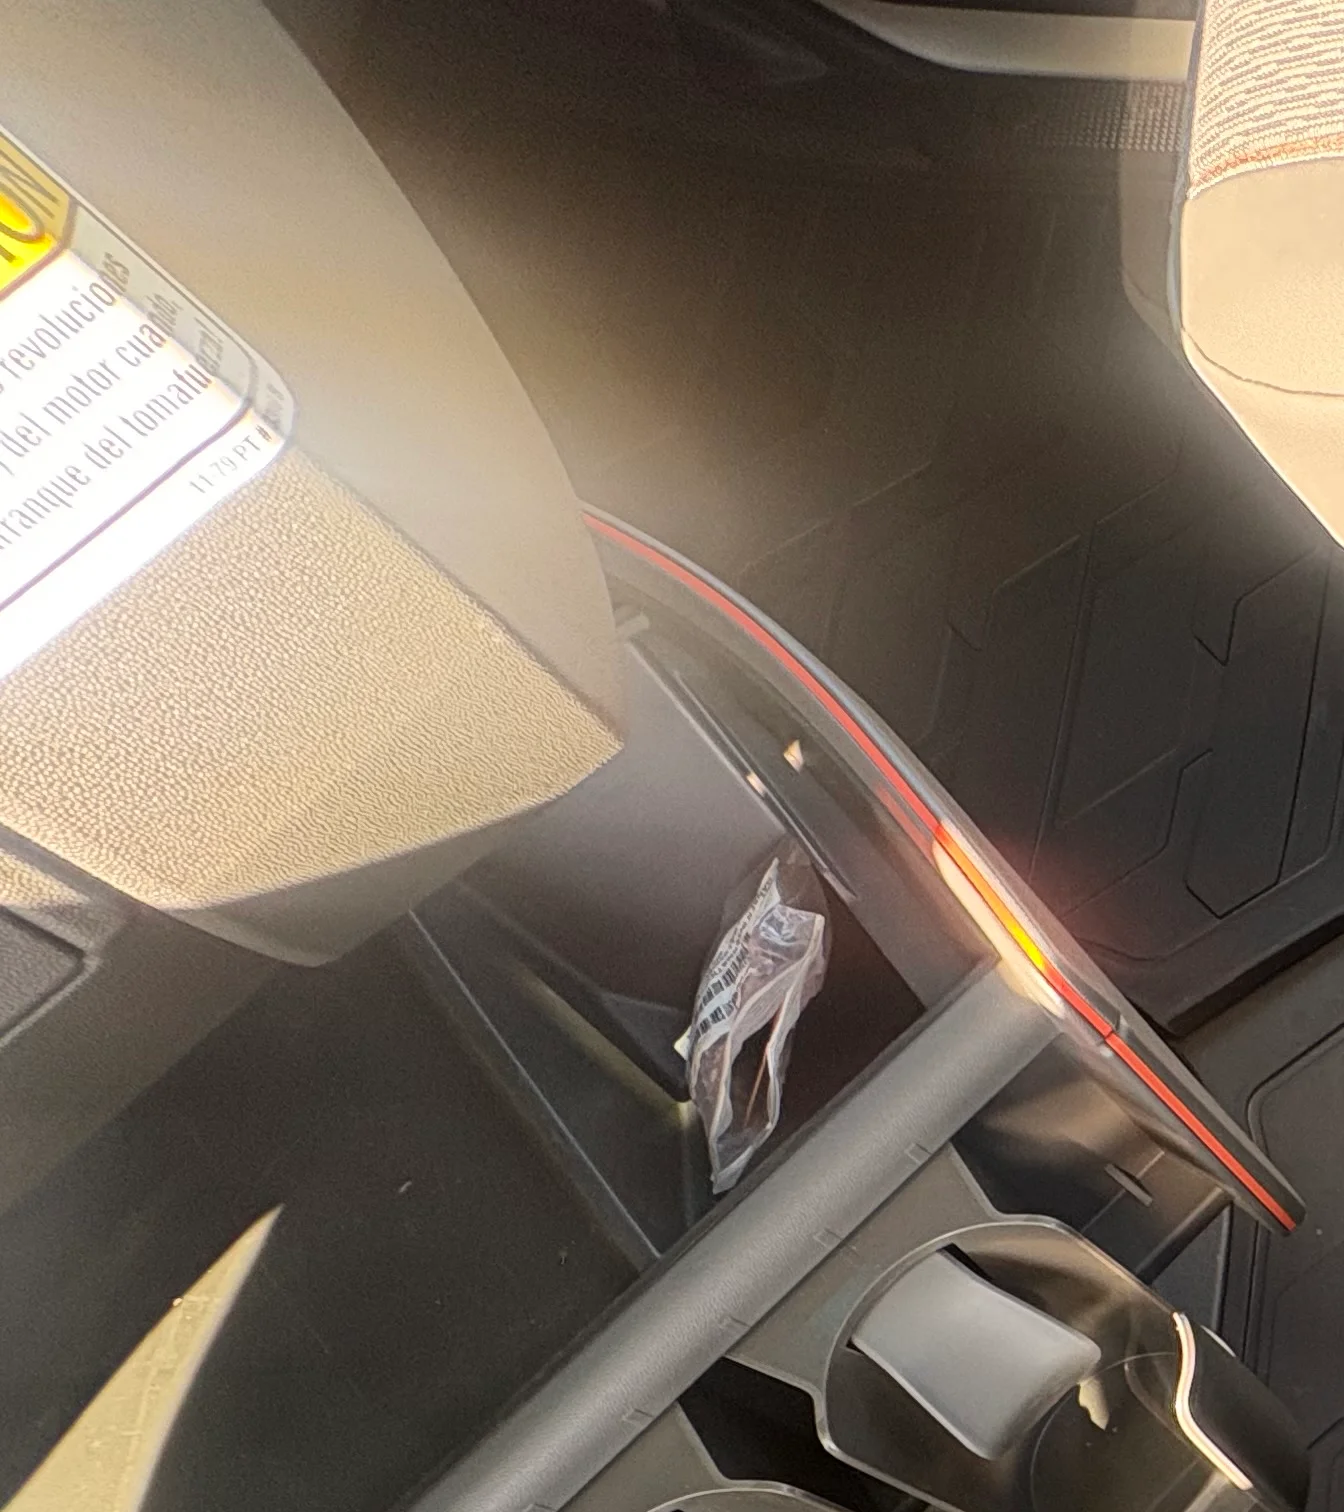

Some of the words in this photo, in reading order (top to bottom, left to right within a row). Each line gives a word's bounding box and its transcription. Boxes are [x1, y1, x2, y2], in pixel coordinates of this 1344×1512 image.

[0, 252, 131, 381] revoluciones
[42, 358, 121, 426] motor
[82, 424, 133, 470] del
